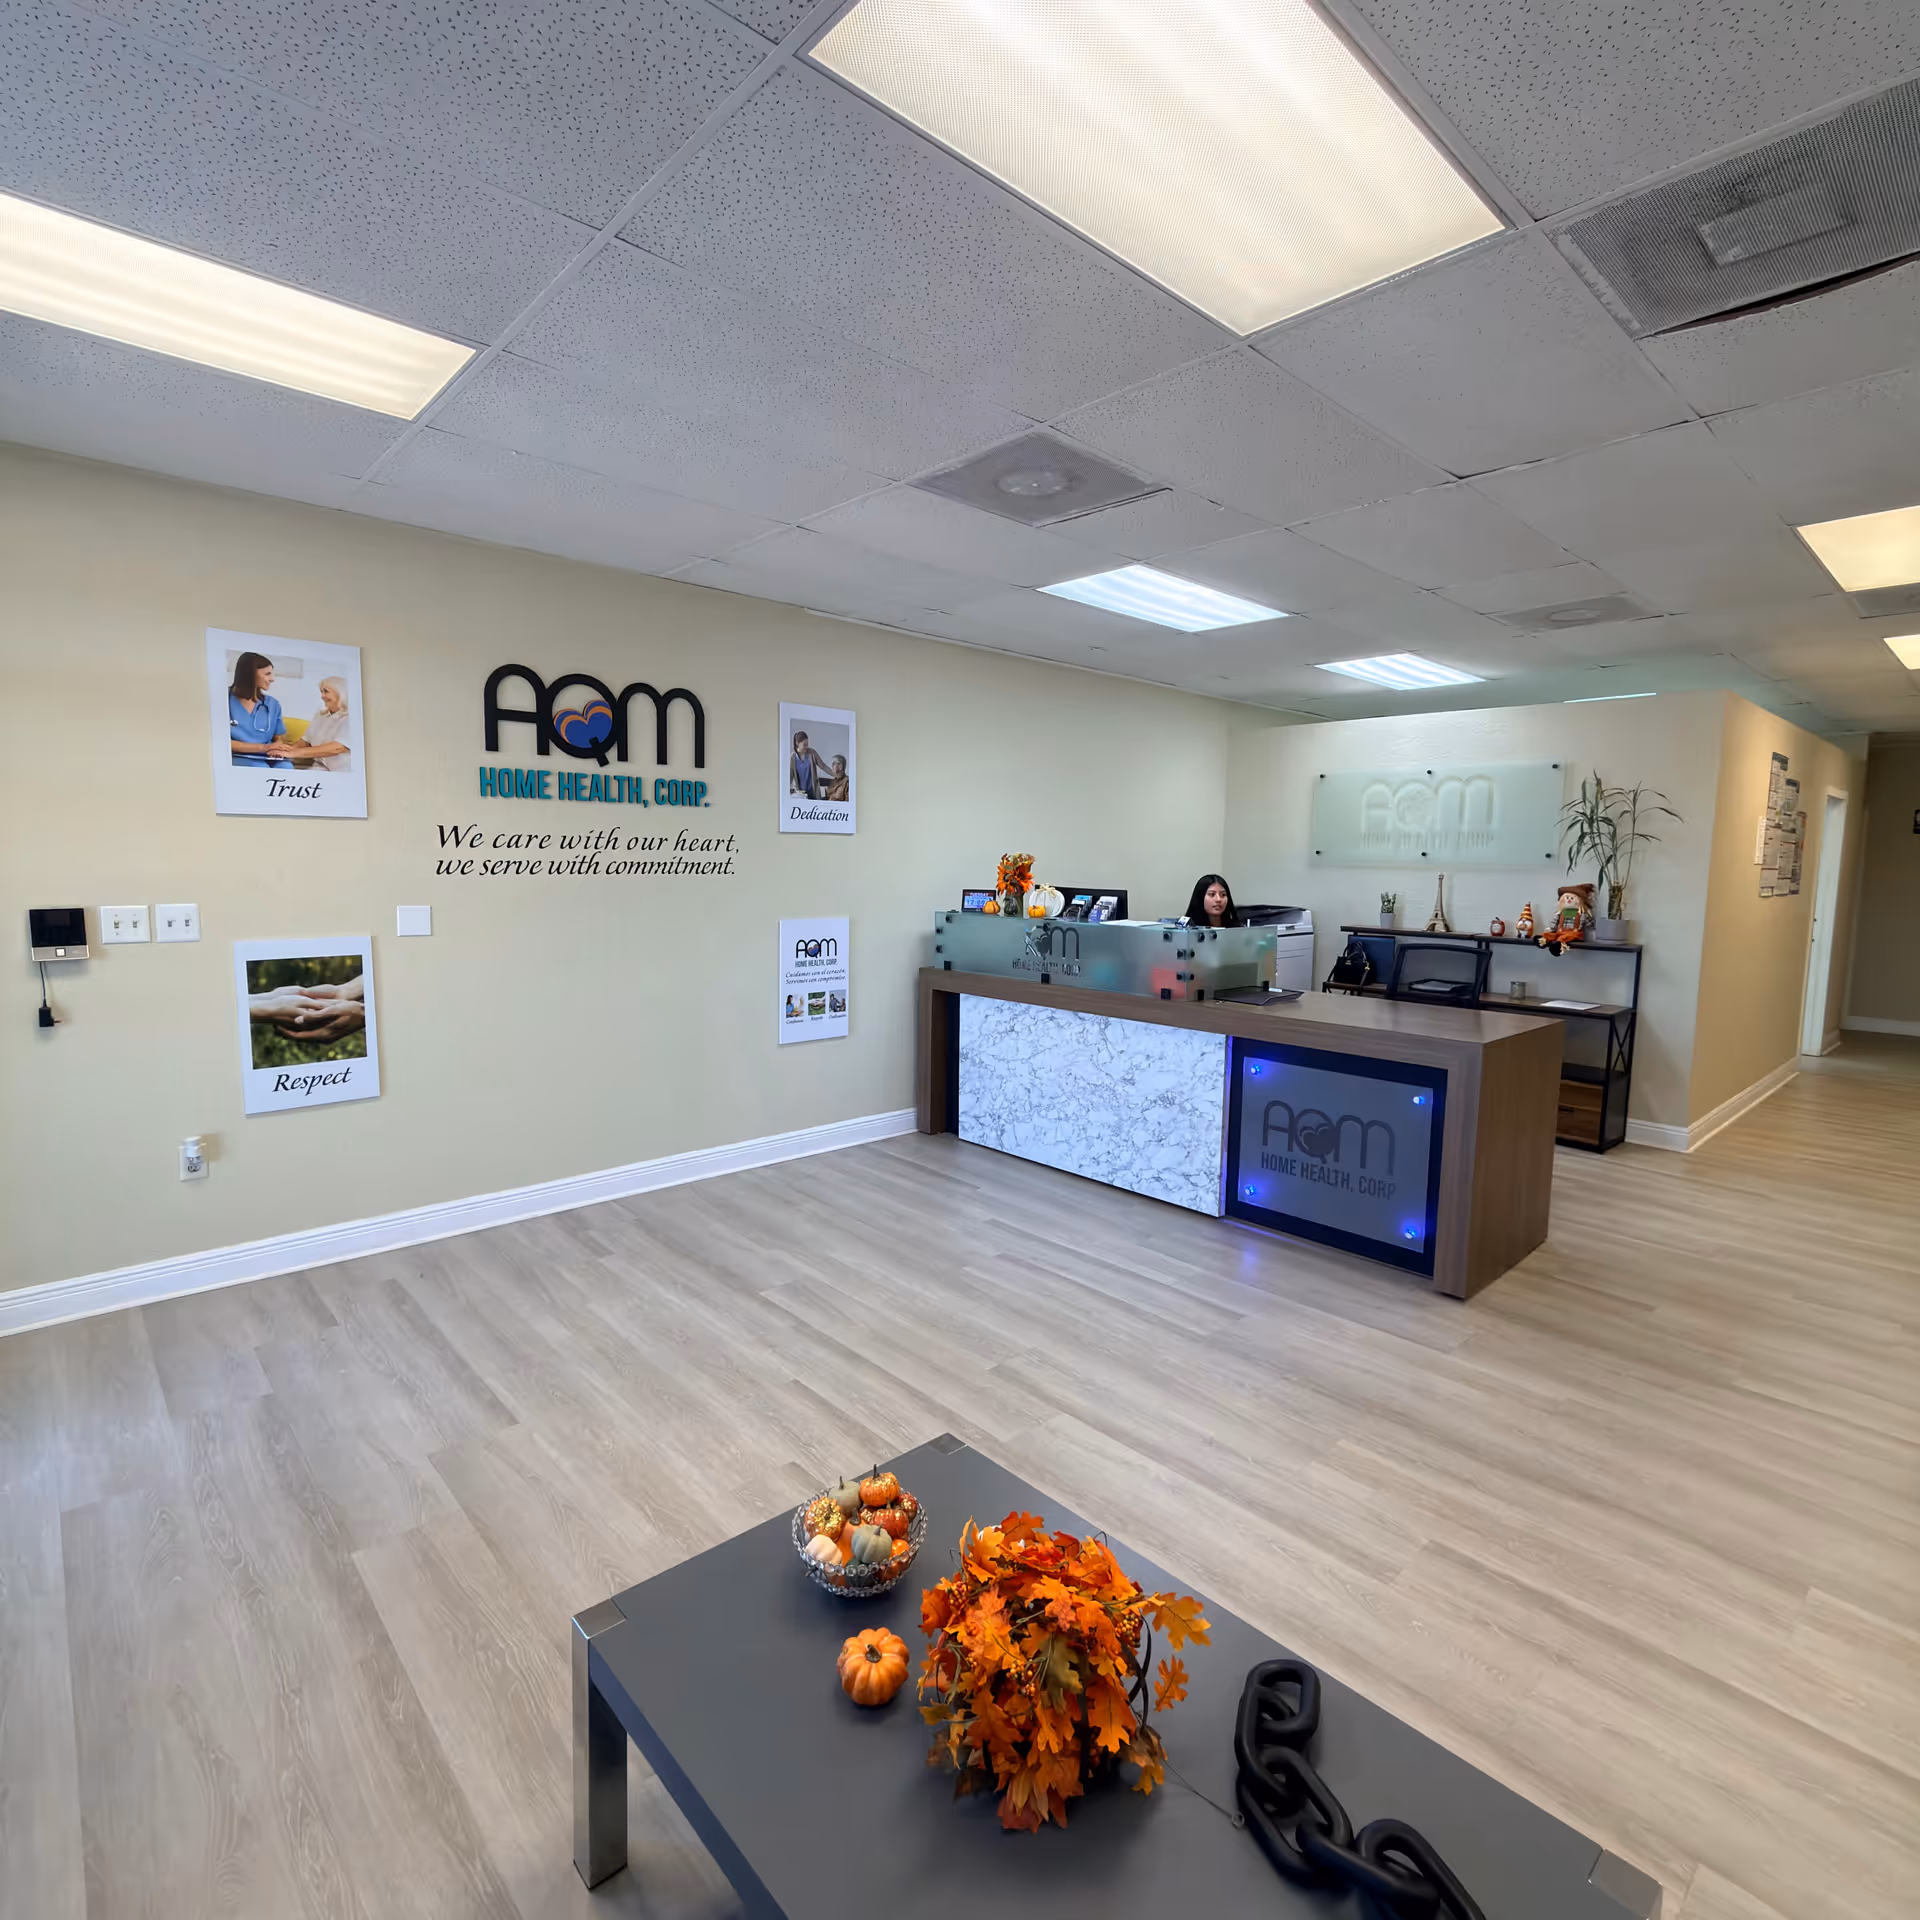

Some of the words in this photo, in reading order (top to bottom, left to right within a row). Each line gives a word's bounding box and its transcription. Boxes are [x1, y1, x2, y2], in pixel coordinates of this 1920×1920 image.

[484, 663, 705, 769] AQM
[266, 778, 323, 799] Trust
[479, 767, 552, 799] HOME
[558, 771, 649, 808] HEALTH,
[655, 778, 711, 808] CORP.
[790, 805, 849, 821] Dedication
[437, 824, 484, 849] We
[492, 832, 551, 849] care
[560, 827, 620, 850] with
[627, 836, 668, 851] our
[673, 829, 739, 854] heart,
[436, 857, 474, 875] we
[479, 857, 543, 876] serve
[549, 851, 602, 875] with
[605, 856, 735, 875] commitment.
[796, 938, 837, 958] AQM
[795, 960, 807, 968] HOME
[272, 1067, 352, 1096] Respect
[1262, 1100, 1396, 1177] AQM
[1261, 1151, 1297, 1177] HOME
